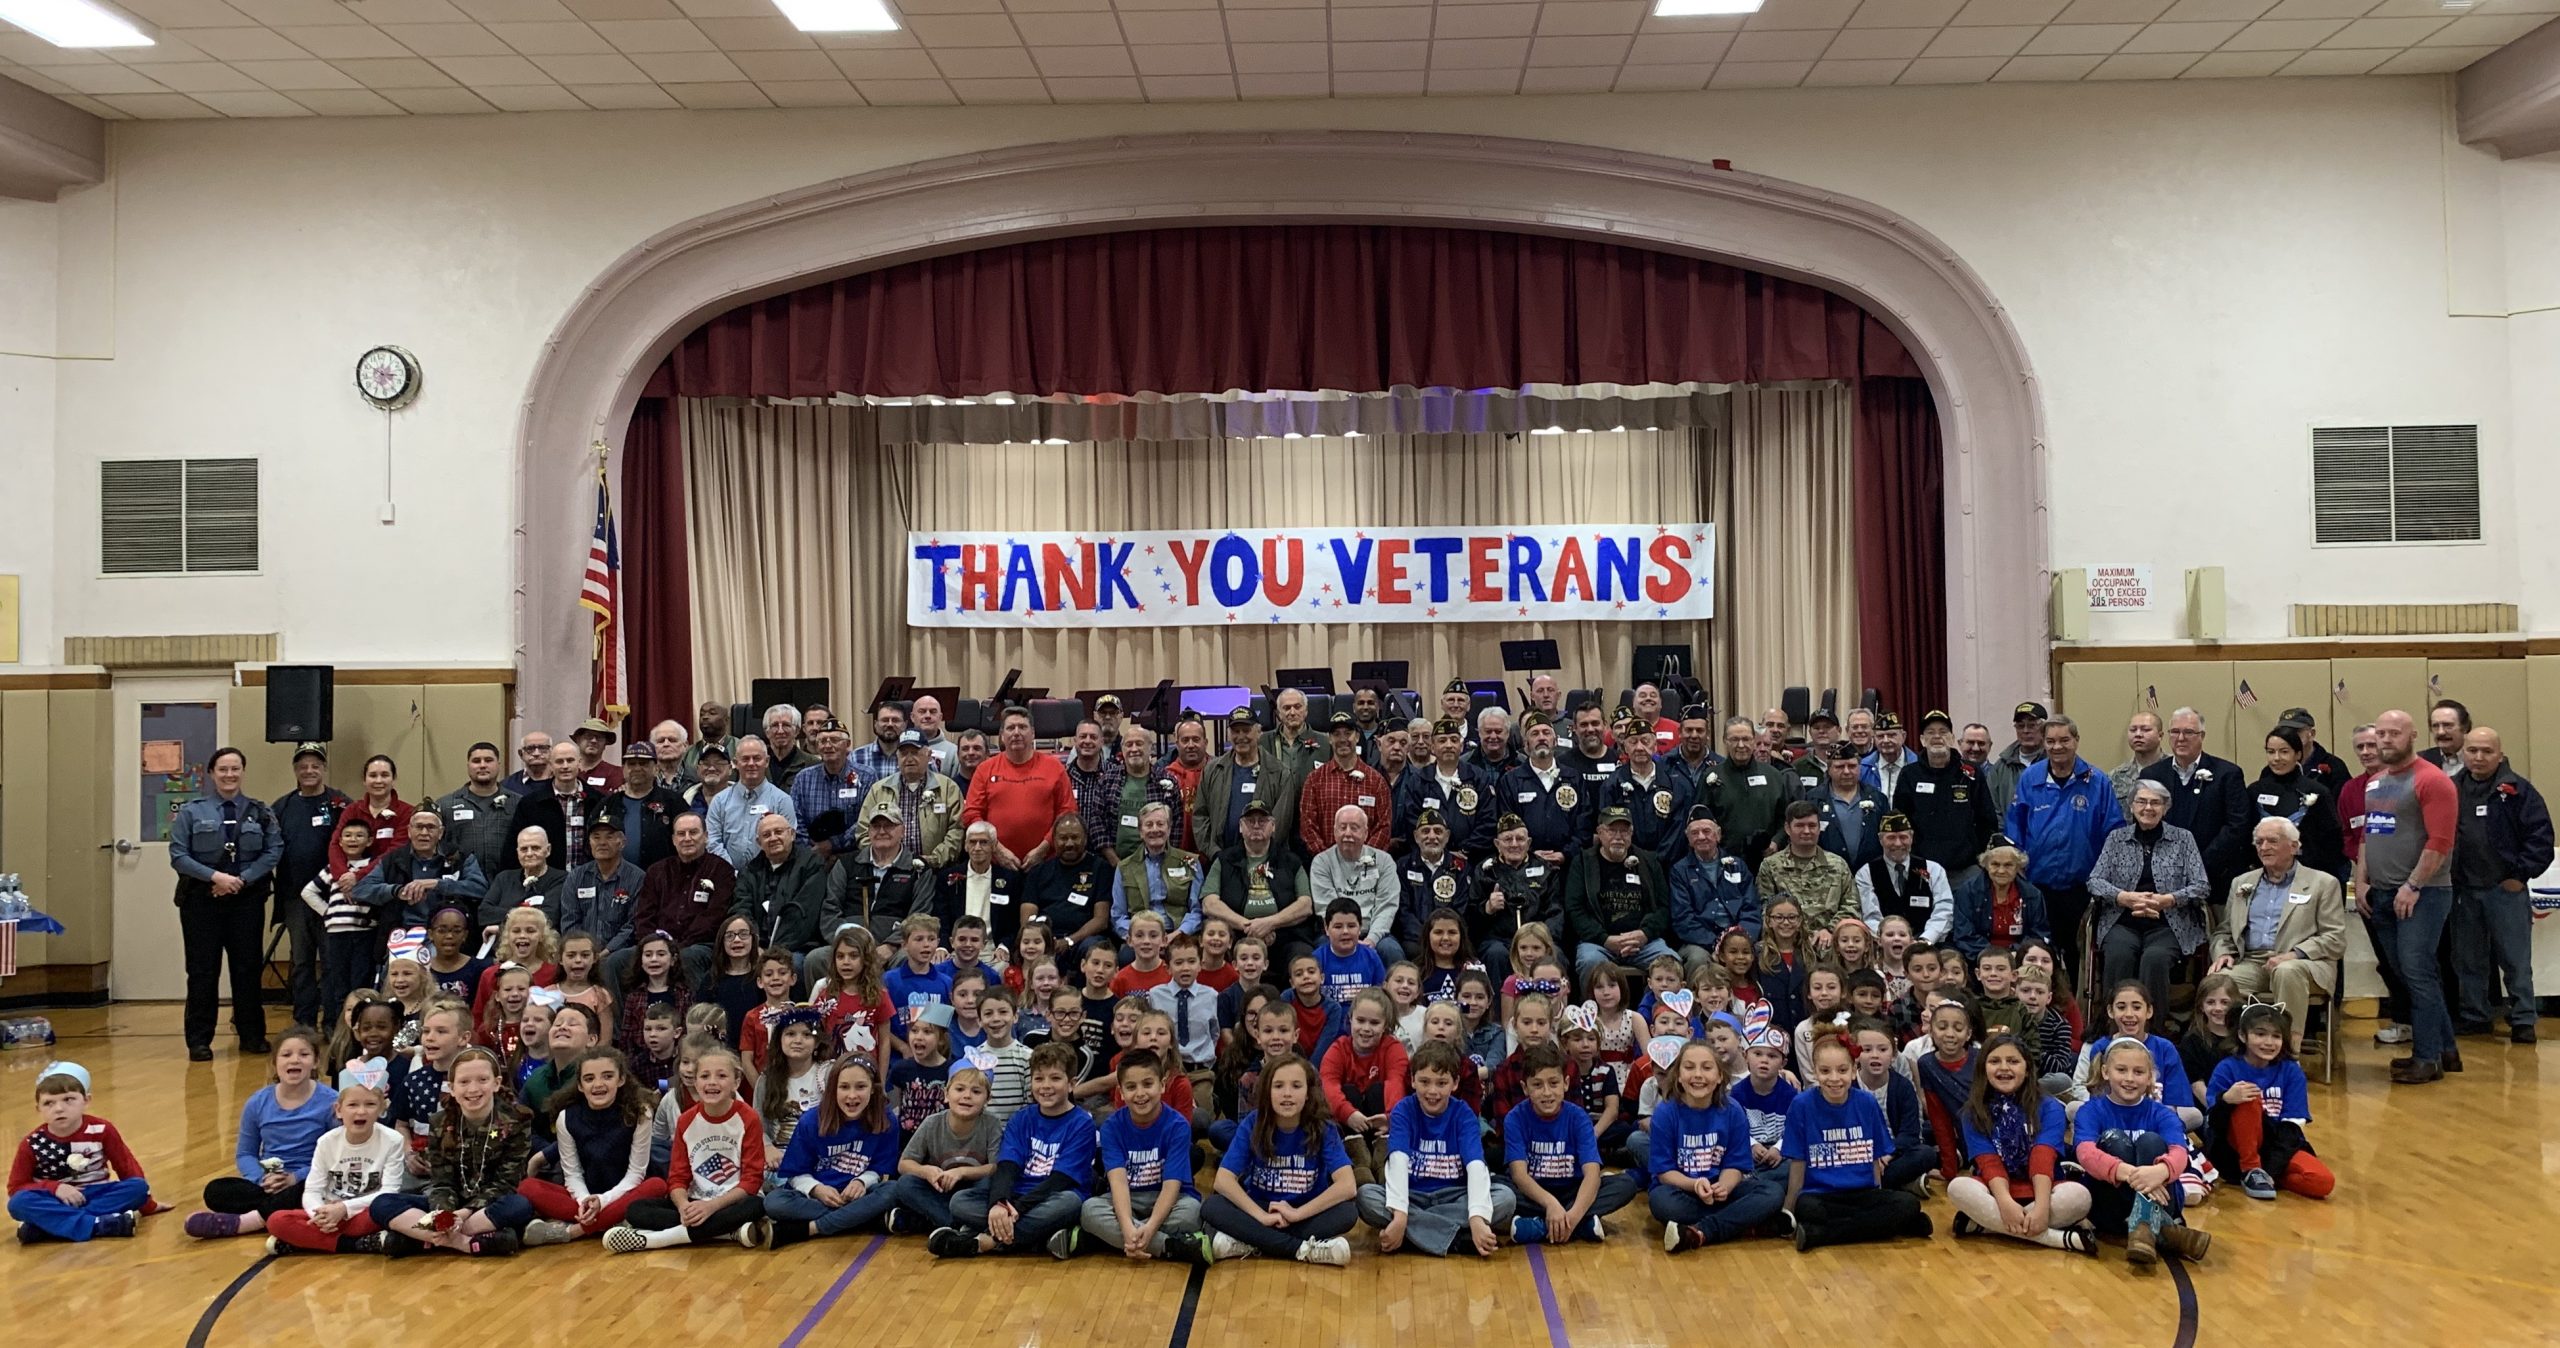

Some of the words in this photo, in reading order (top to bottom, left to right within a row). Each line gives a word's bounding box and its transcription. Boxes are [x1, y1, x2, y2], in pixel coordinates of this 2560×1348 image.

[914, 541, 1138, 611] THANK
[1168, 534, 1304, 607] YOU
[1329, 535, 1692, 604] VETERANS
[2097, 568, 2135, 577] MAXIMUM
[2092, 578, 2140, 587] OCCUPANCY
[2086, 588, 2102, 597] NOT
[2105, 588, 2114, 597] TO
[2117, 588, 2147, 597] EXCEED
[2108, 598, 2145, 607] PERSONS
[1600, 891, 1642, 899] VIETNAM
[1822, 1128, 1848, 1142] THANK
[1848, 1125, 1864, 1140] YOU
[701, 1135, 721, 1146] STATES
[1292, 1154, 1305, 1169] YOU
